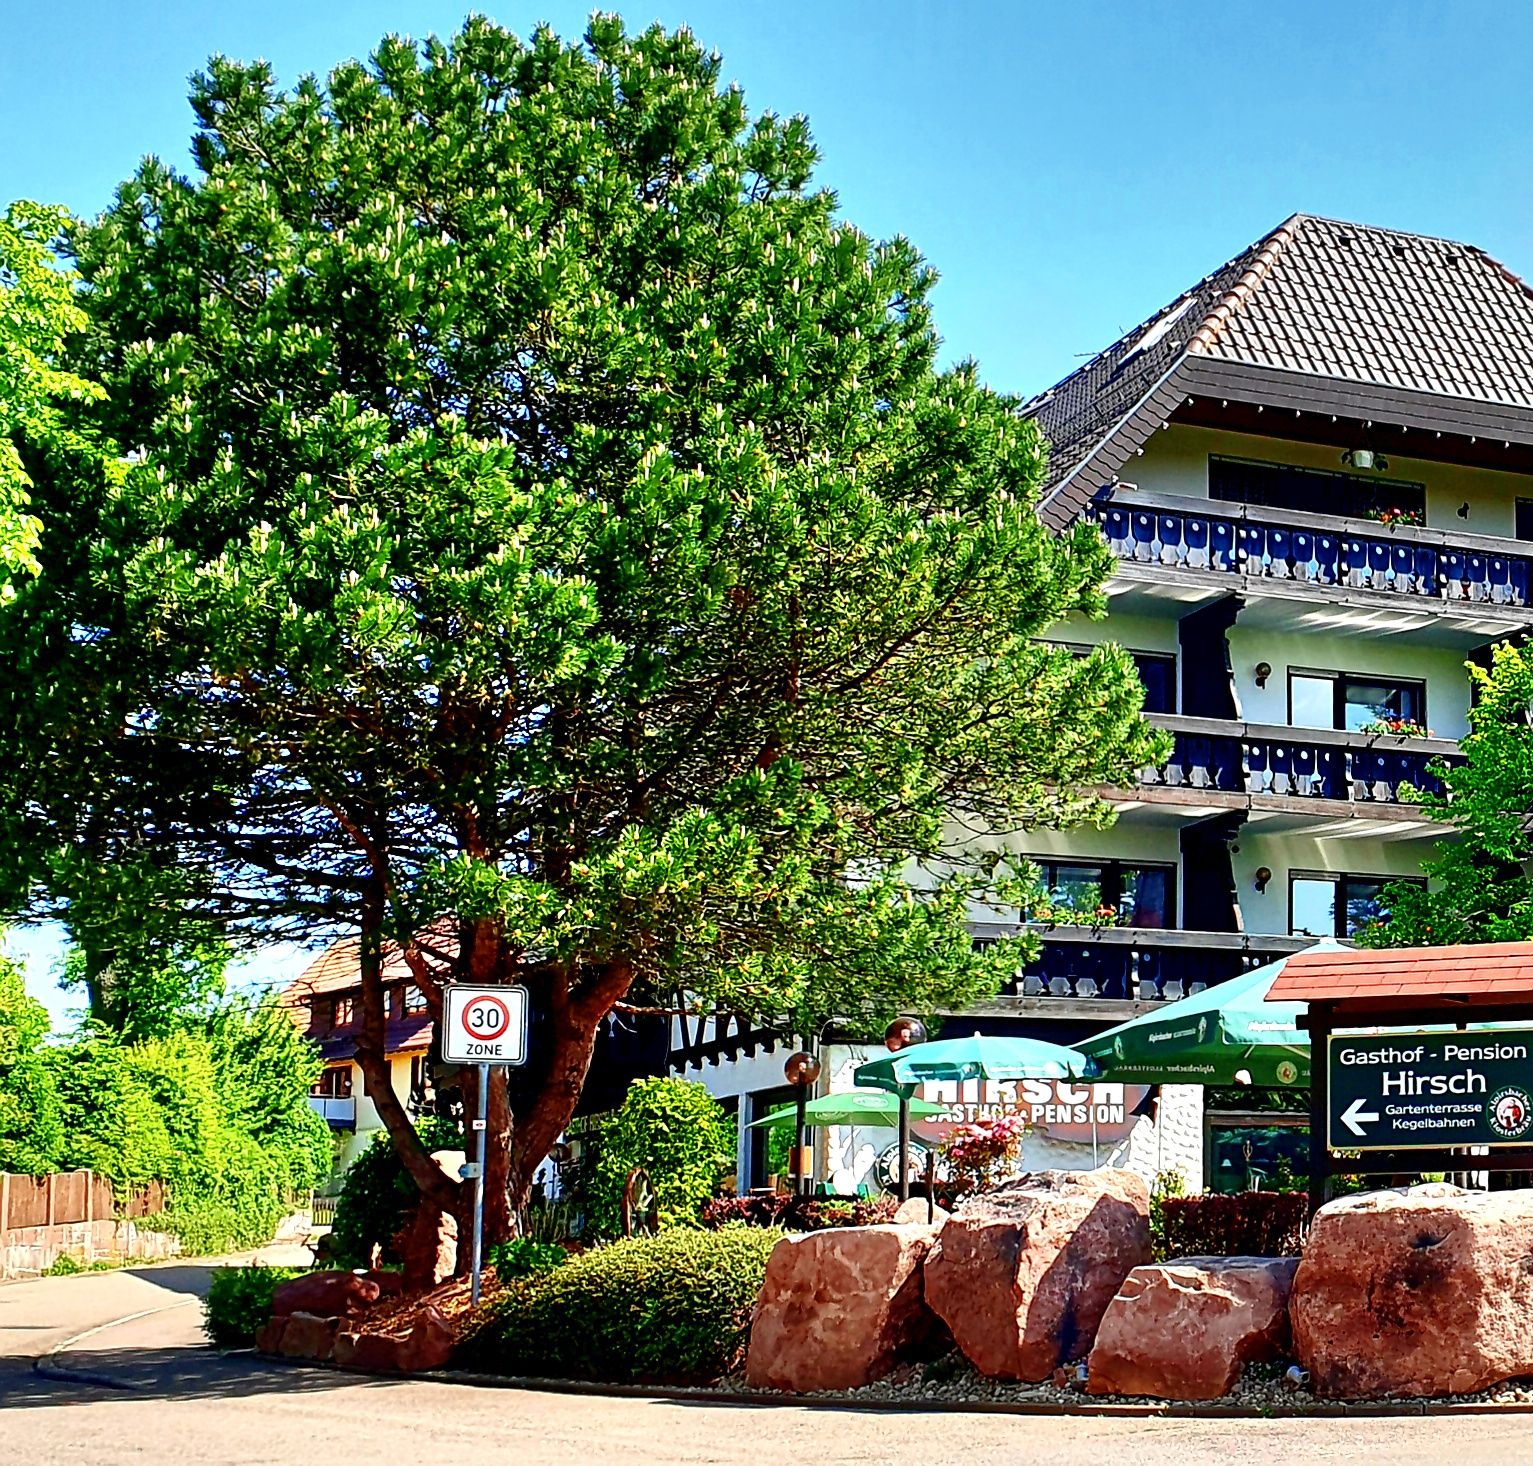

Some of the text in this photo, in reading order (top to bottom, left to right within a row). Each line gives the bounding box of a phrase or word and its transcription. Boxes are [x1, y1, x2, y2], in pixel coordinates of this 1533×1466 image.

[471, 1008, 499, 1028] 30
[466, 1044, 503, 1056] ZONE
[1339, 1046, 1425, 1066] Gasthof
[1444, 1043, 1527, 1061] Pension
[1382, 1069, 1487, 1096] Hirsch
[1031, 1104, 1124, 1123] PENSION
[1385, 1102, 1482, 1115] Gartenterrasse
[1392, 1117, 1475, 1131] Kegelbahnen
